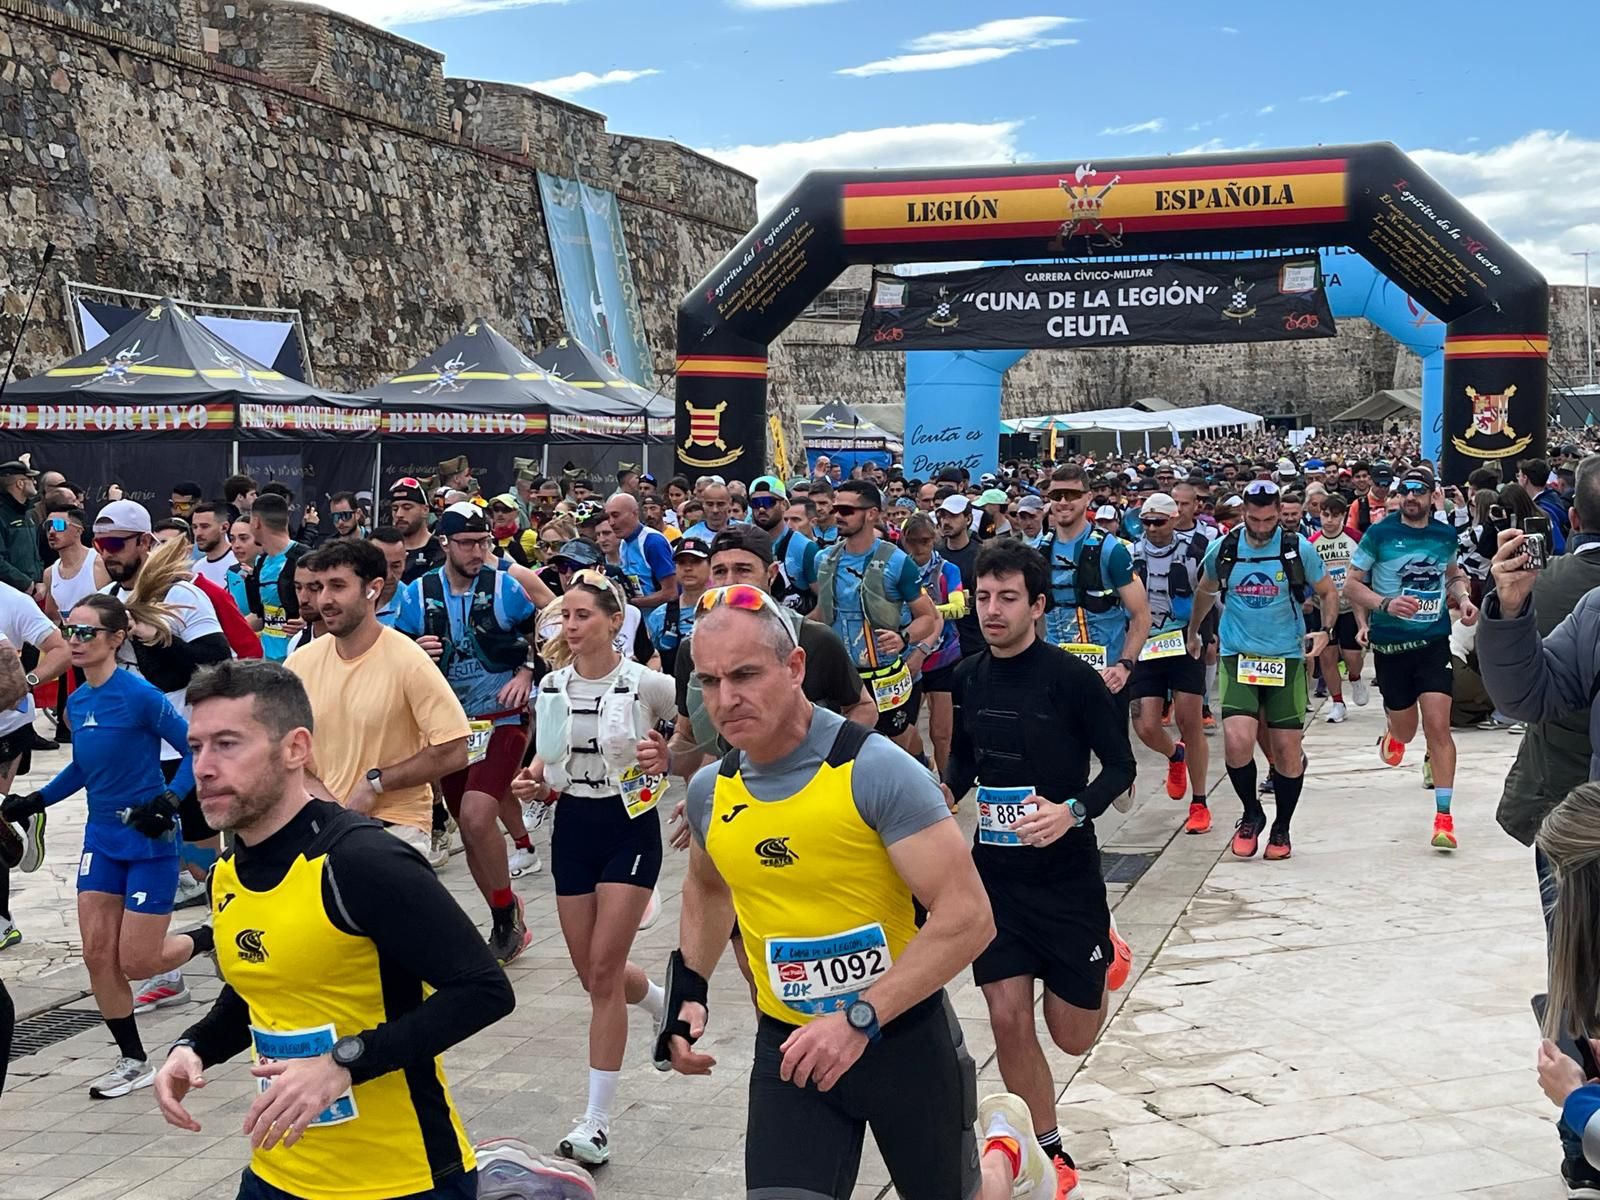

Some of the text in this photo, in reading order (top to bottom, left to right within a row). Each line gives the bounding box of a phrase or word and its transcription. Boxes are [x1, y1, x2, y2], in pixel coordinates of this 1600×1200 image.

[907, 182, 1295, 222] LEGIÓN ESPAÑOLA
[1392, 178, 1437, 220] Espíritu
[1436, 218, 1450, 231] de
[1448, 228, 1461, 240] la
[742, 246, 756, 266] del
[1025, 268, 1153, 282] CARRERA CÍVICO-MILITAR
[962, 280, 1218, 311] “CUNA DE LA LEGIÓN”
[1046, 315, 1130, 338] CEUTA
[0, 404, 208, 430] B DEPORTIVO
[240, 404, 284, 428] TERCIO
[389, 412, 526, 434] DEPORTIVO
[966, 430, 984, 440] es
[1320, 551, 1350, 560] AVALLS
[1256, 662, 1283, 674] 4462
[814, 950, 885, 986] 1092
[783, 982, 812, 997] 20K
